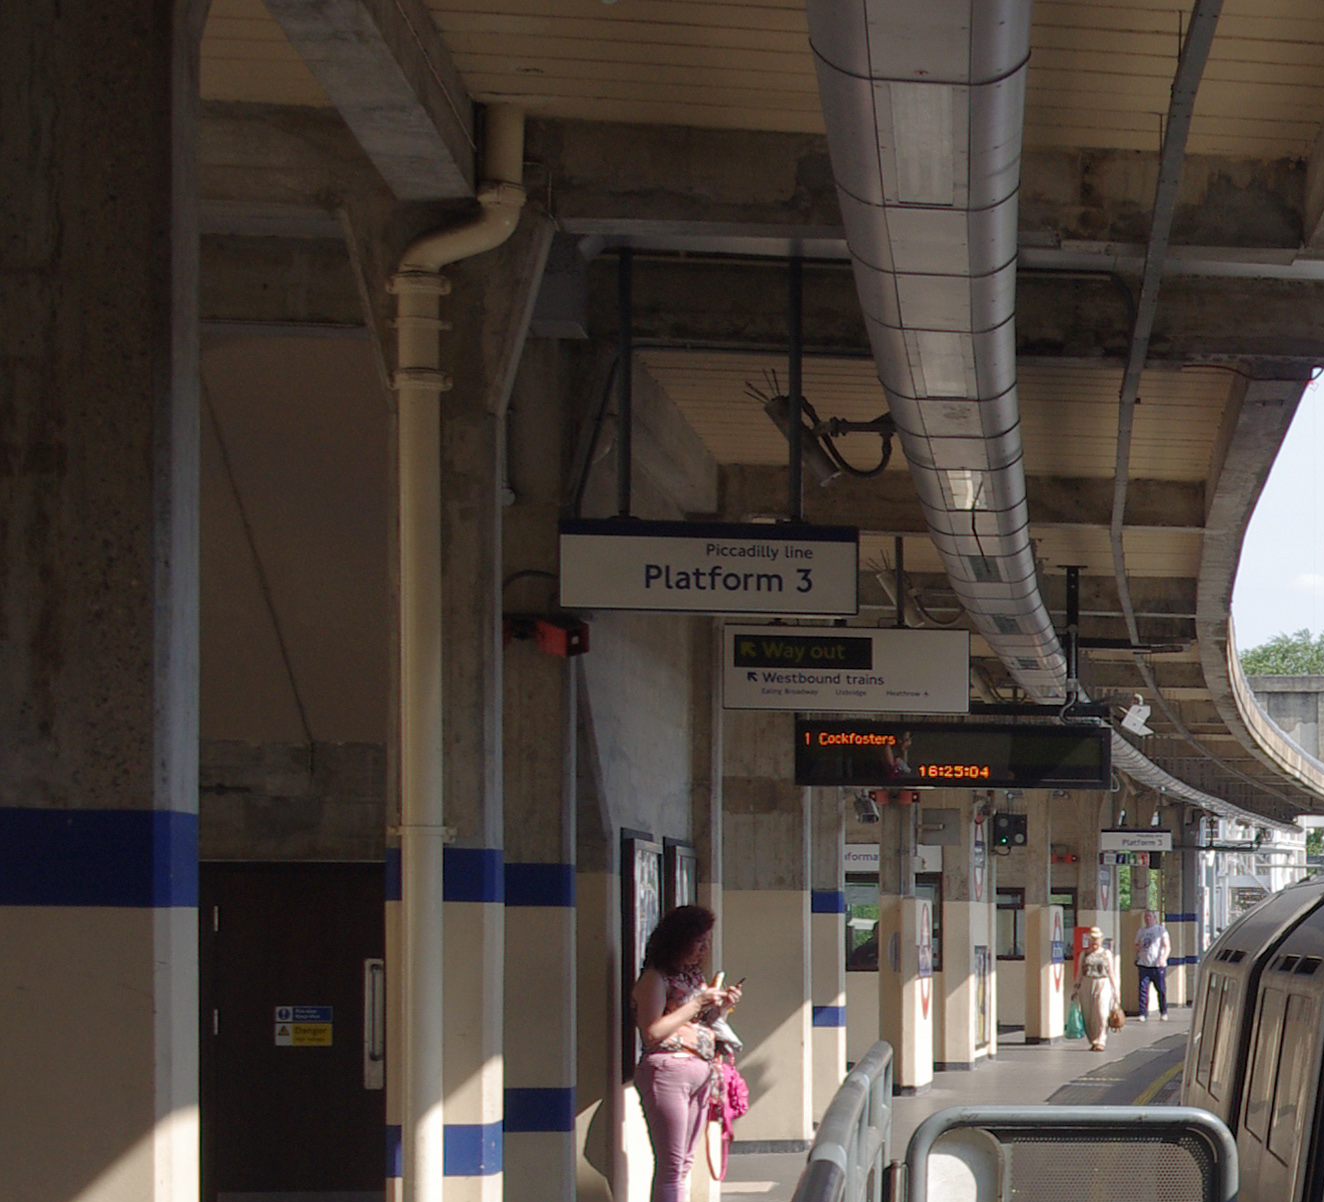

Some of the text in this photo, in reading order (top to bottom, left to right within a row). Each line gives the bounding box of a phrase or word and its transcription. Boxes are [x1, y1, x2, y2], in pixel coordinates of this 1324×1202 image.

[706, 543, 813, 561] Piccadilly line
[645, 564, 813, 593] Platform 3
[762, 640, 846, 662] Way out
[762, 672, 885, 686] Westbound trains
[835, 688, 867, 698] Uxbridge
[804, 731, 896, 746] 1 Cockfosters
[918, 764, 990, 779] 16:25:04
